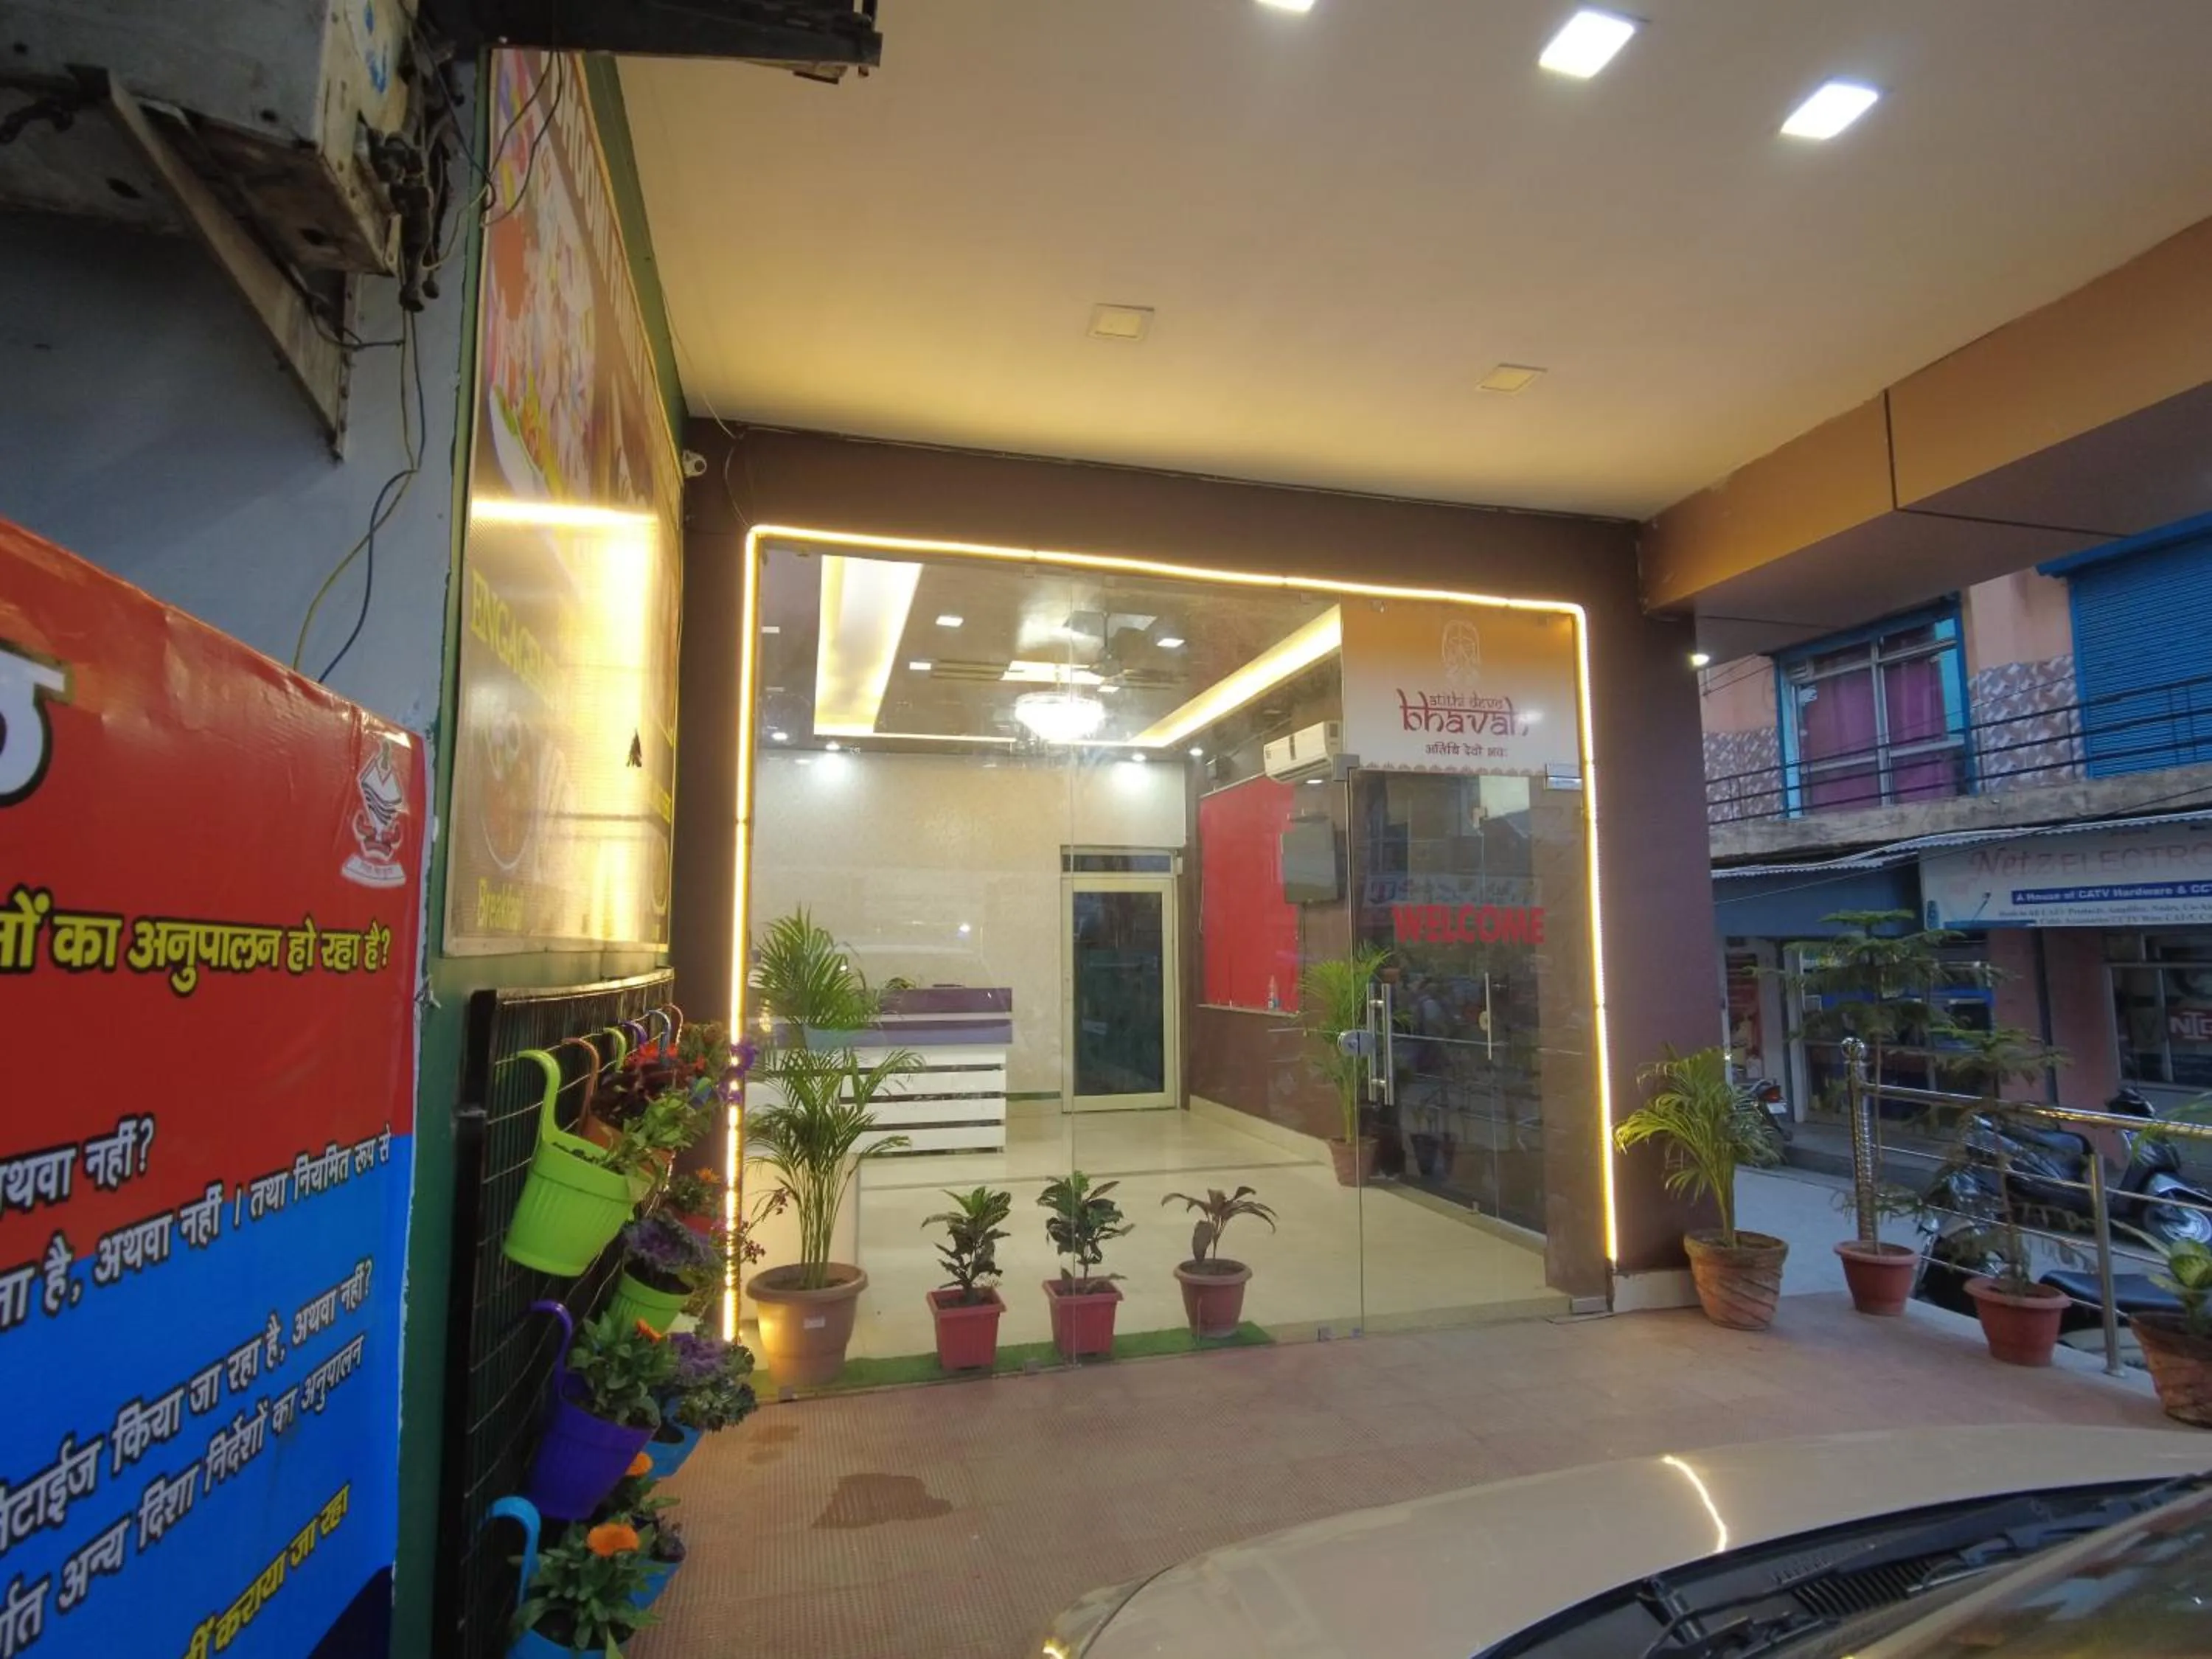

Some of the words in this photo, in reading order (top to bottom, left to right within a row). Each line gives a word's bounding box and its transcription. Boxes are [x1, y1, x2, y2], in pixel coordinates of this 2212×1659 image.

[1391, 903, 1546, 945] WELCOME
[2079, 888, 2110, 899] CATV
[2177, 886, 2187, 894] &
[52, 915, 123, 967] का
[128, 920, 282, 993] अनुपालन
[287, 917, 317, 972] हो
[321, 932, 361, 971] रहा
[94, 1214, 174, 1282] अथवा
[180, 1183, 223, 1245] नहीं
[251, 1172, 288, 1217] तथा
[293, 1152, 352, 1201] नियमित
[354, 1138, 377, 1174] रूप
[379, 1121, 392, 1163] से
[112, 1388, 184, 1473] किया
[189, 1364, 223, 1405] जा
[227, 1337, 262, 1391] रहा
[292, 1289, 338, 1345] अथवा
[58, 1517, 131, 1608] अन्य
[138, 1464, 201, 1548] दिशा
[273, 1387, 299, 1433] का
[301, 1335, 365, 1411] अनुपालन
[290, 1518, 318, 1568] जा
[320, 1484, 351, 1535] रहा
